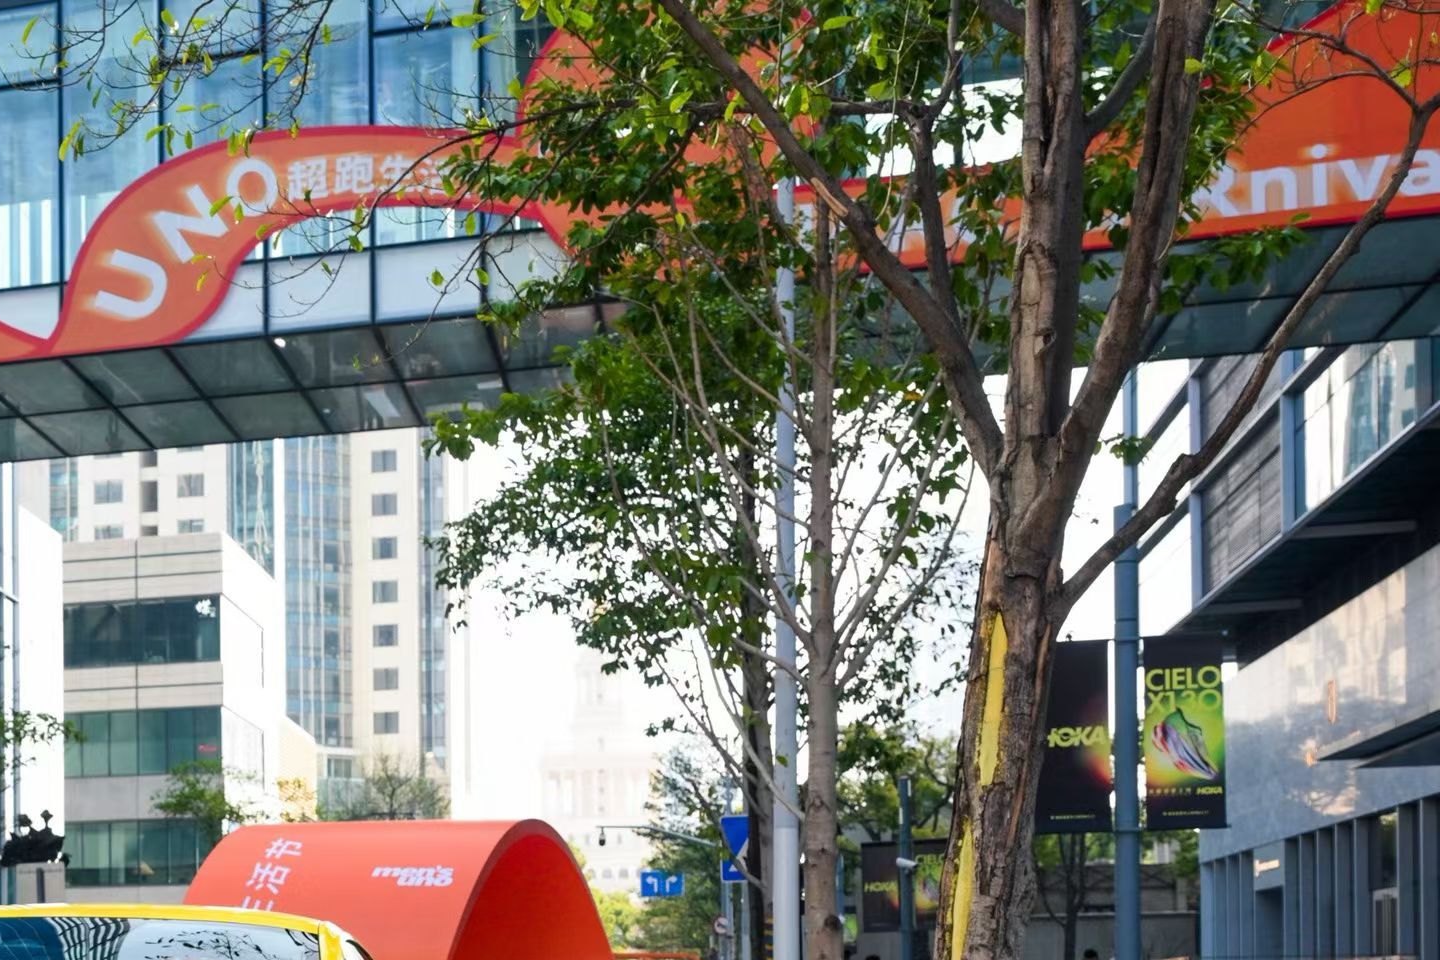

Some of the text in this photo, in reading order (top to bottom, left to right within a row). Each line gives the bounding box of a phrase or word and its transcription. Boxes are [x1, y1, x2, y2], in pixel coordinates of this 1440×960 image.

[95, 158, 278, 320] UNO
[1146, 665, 1221, 692] CIELO
[371, 864, 454, 878] men's
[396, 874, 454, 887] uno
